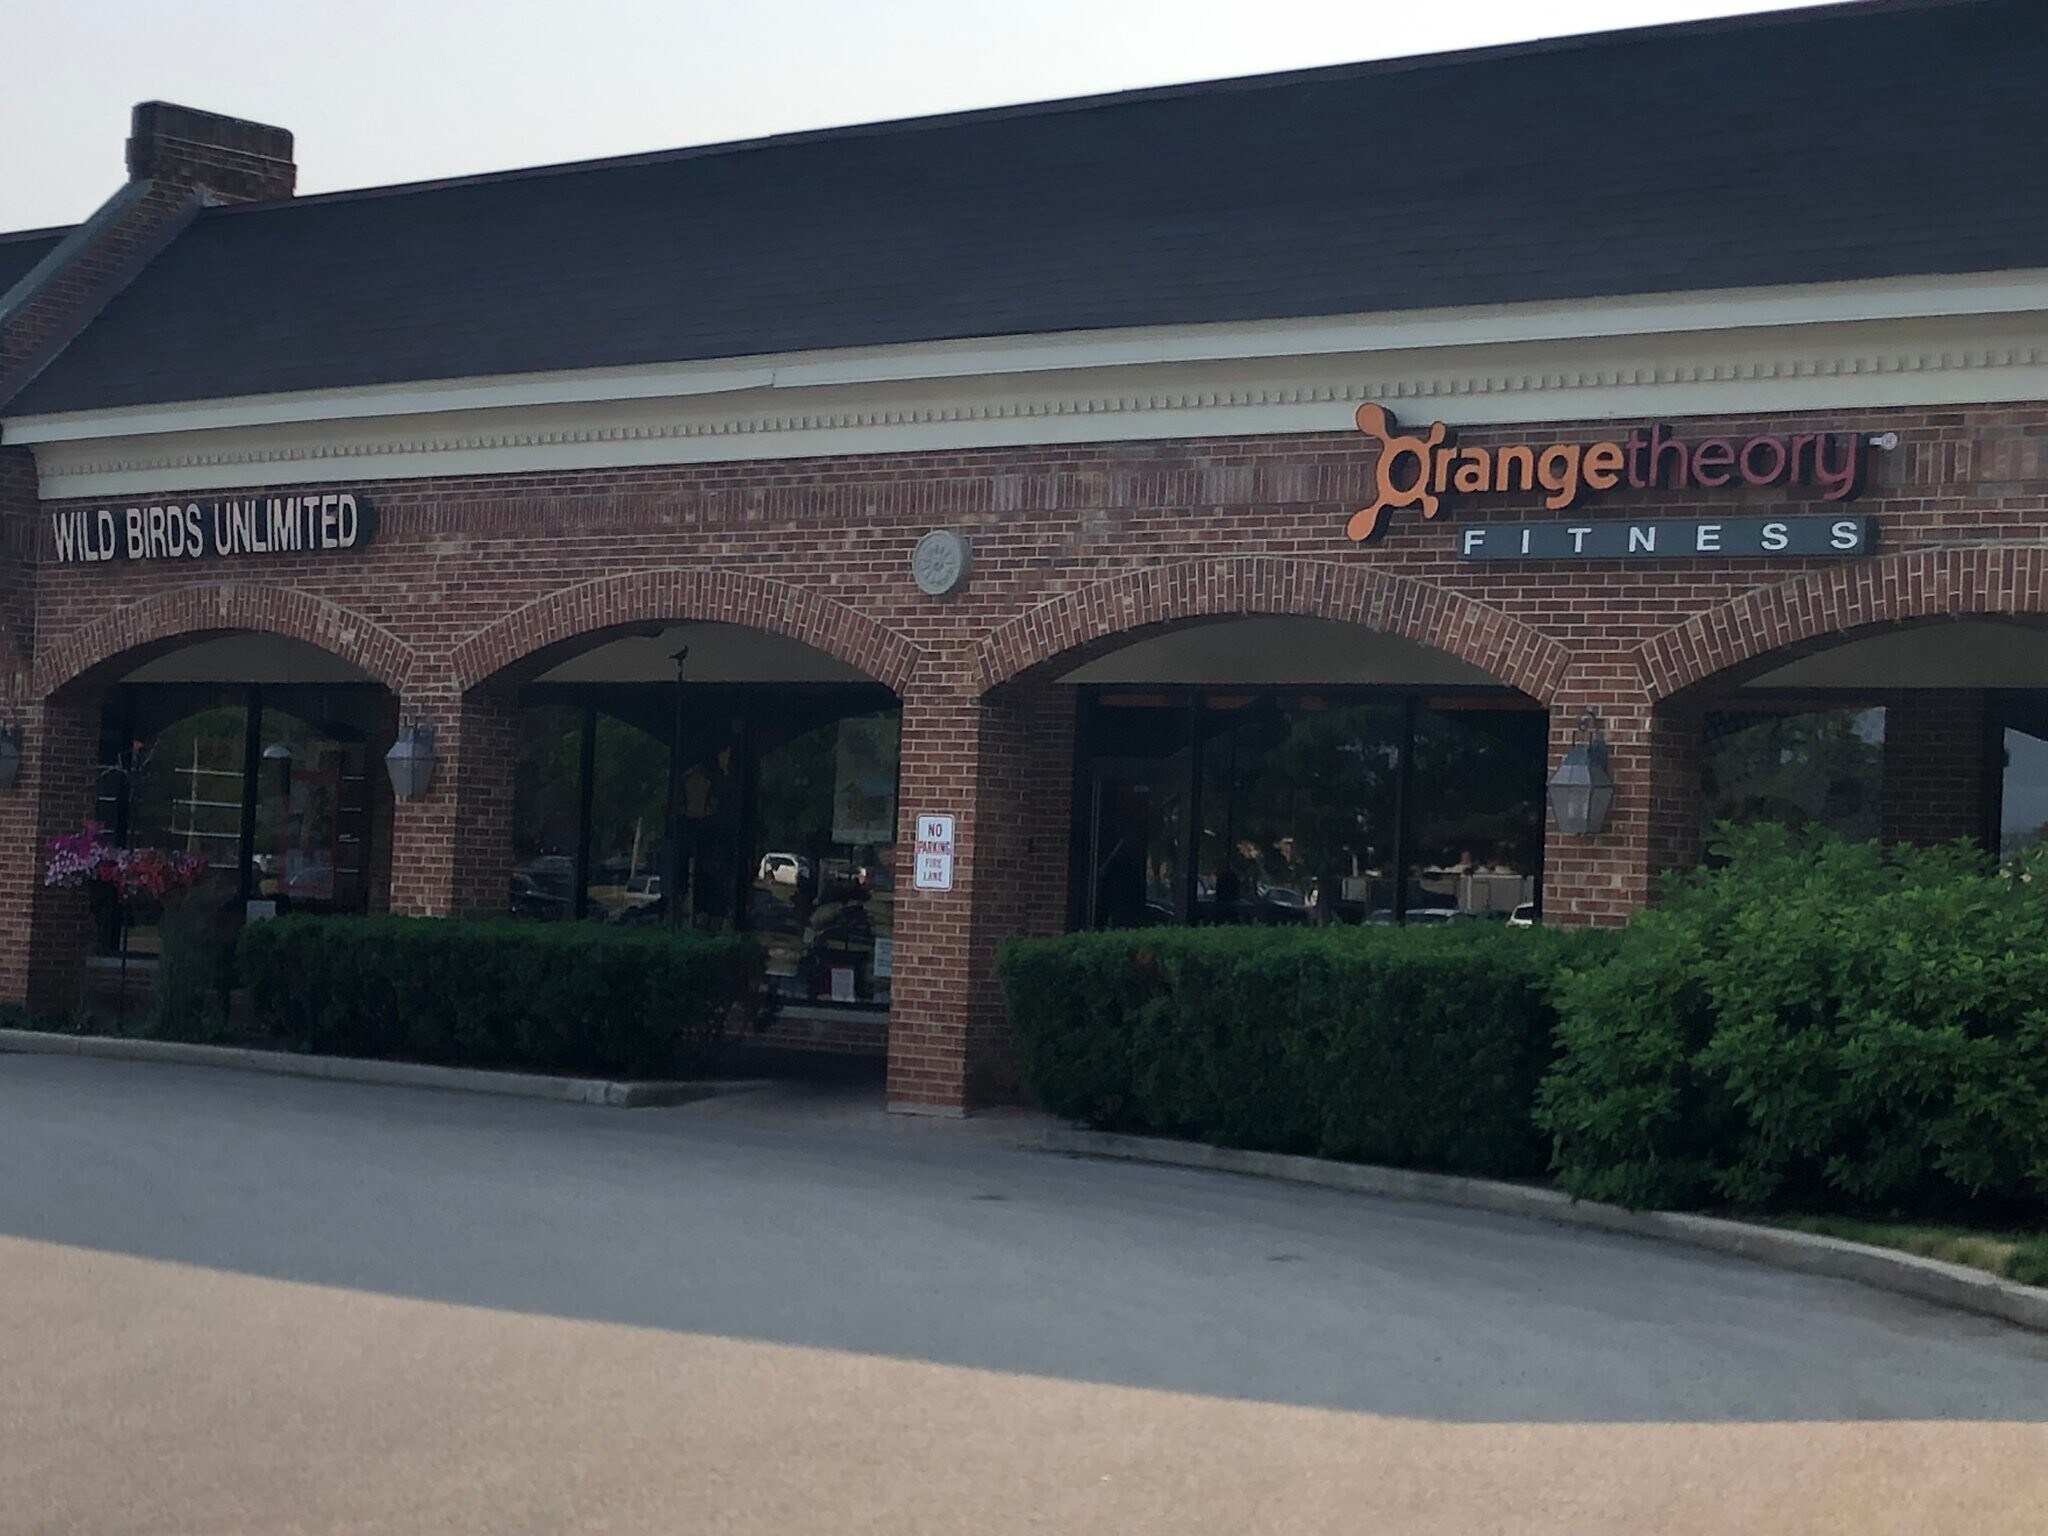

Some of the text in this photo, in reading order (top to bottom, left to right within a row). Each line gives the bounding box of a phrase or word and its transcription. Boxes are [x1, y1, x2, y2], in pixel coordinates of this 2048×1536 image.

[53, 494, 358, 562] WILD BIRDS UNLIMITED
[1463, 521, 1859, 555] FITNESS
[928, 823, 943, 837] NO
[918, 841, 951, 856] PARKING
